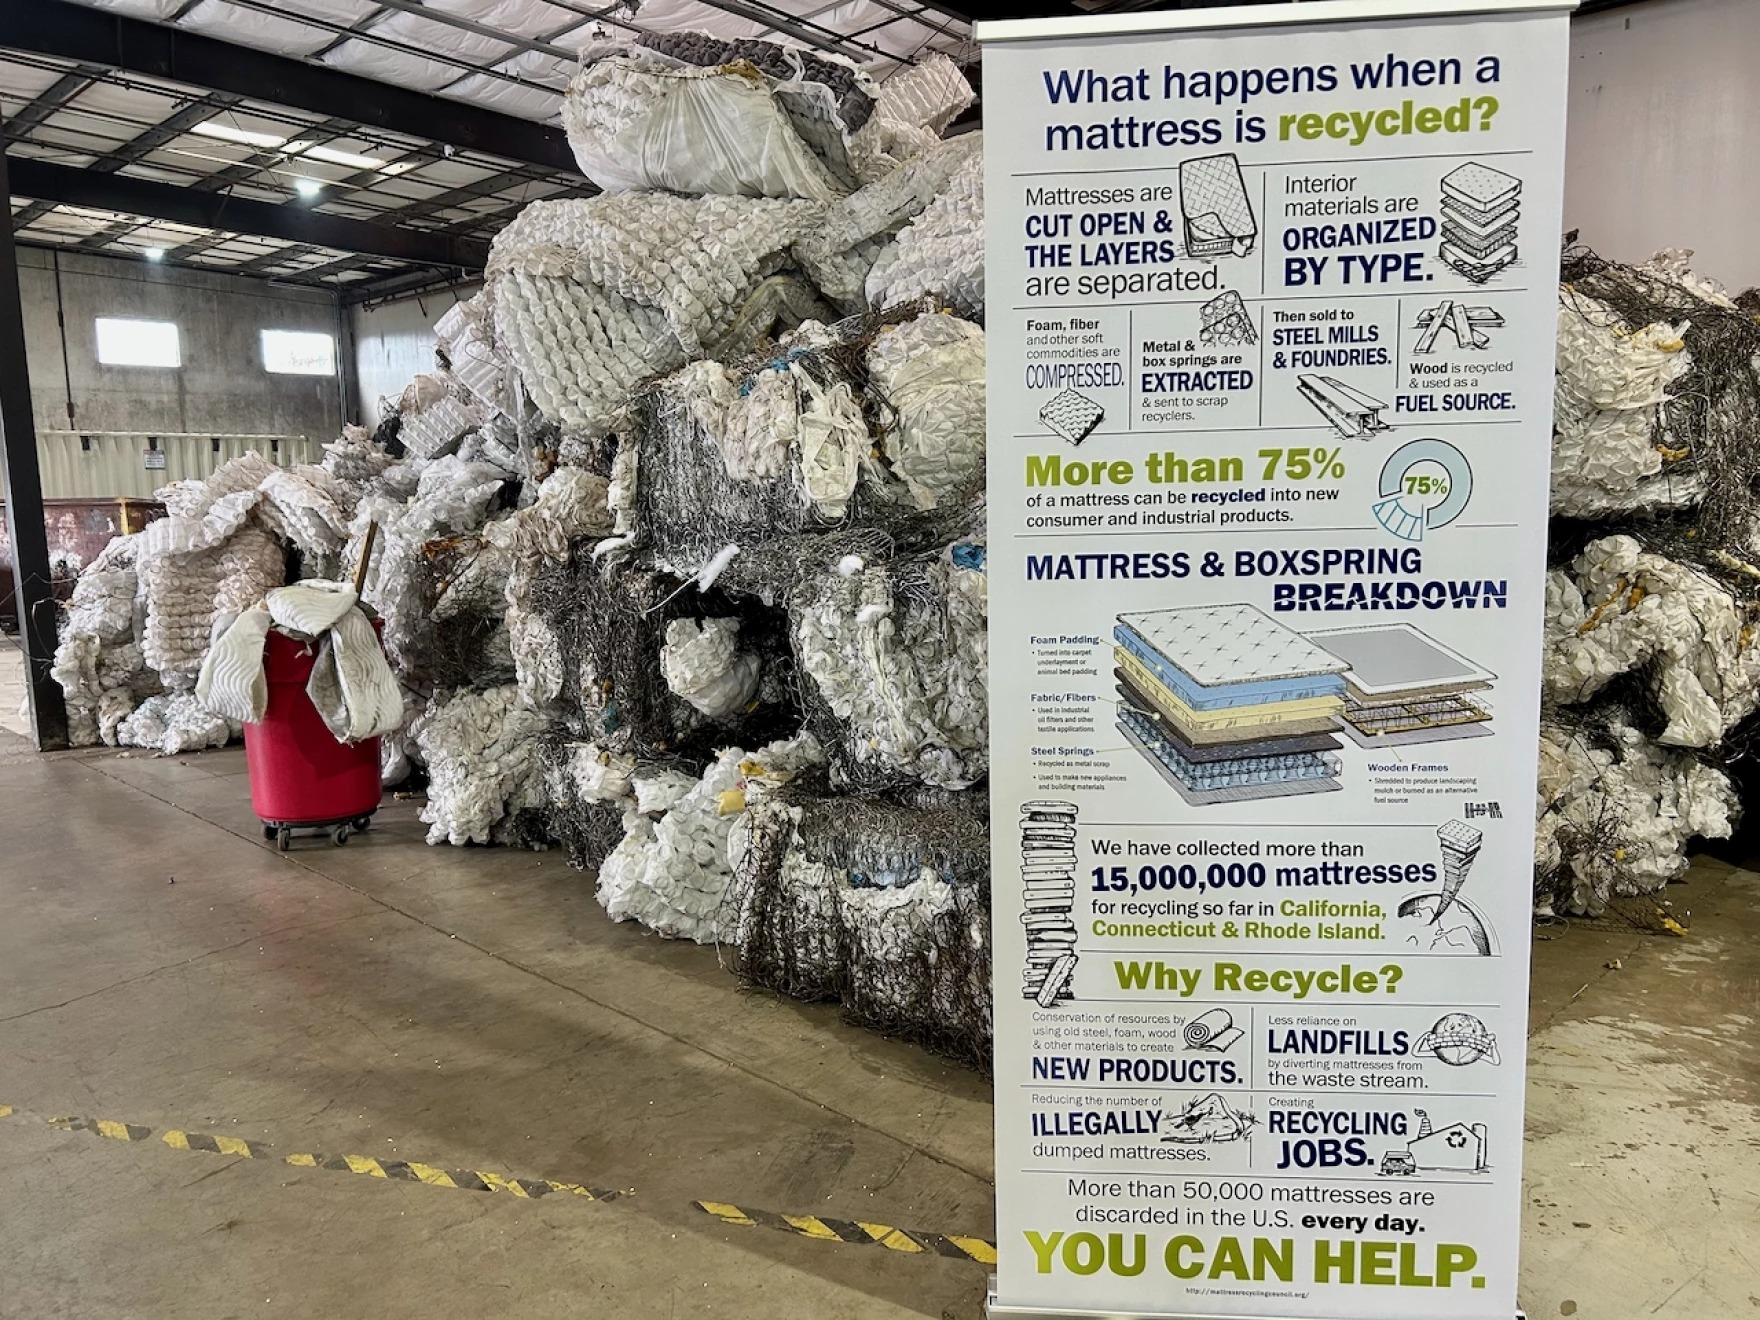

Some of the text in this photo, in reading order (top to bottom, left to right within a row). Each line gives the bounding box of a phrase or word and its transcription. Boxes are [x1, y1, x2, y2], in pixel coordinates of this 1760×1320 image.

[1043, 54, 1499, 105] What happens when a
[1047, 96, 1499, 150] mattress is recycled?
[1286, 174, 1357, 194] Interior
[1027, 187, 1172, 206] Mattresses are
[1286, 196, 1418, 216] materials are
[1026, 210, 1172, 238] CUT OPEN &
[1283, 217, 1436, 251] ORGANIZED
[1025, 240, 1175, 268] THE LAYERS
[1285, 253, 1433, 286] BY TYPE.
[1026, 265, 1226, 298] are separated.
[1027, 319, 1099, 331] Foam, fiber
[1273, 309, 1354, 322] Then sold to
[1027, 333, 1103, 345] and other soft
[1273, 325, 1378, 346] STEEL MILLS
[1027, 347, 1120, 359] commodities are
[1143, 340, 1195, 352] Metal &
[1143, 354, 1242, 368] box springs are
[1273, 348, 1391, 369] & FOUNDRIES.
[1410, 361, 1513, 374] Wood is recycled
[1026, 363, 1124, 389] COMPRESSED.
[1142, 370, 1253, 392] EXTRACTED
[1396, 392, 1515, 412] FUEL SOURCE.
[1142, 411, 1195, 423] recyclers.
[1027, 448, 1345, 486] More than 75%
[1405, 476, 1447, 494] 75%
[1027, 488, 1339, 508] of a mattress can be recycled into new
[1027, 509, 1293, 527] consumer and industrial products.
[1027, 548, 1421, 580] MATTRESS & BOXSPRING
[1274, 580, 1506, 611] BREAKDOWN
[1031, 635, 1099, 645] Foam Padding
[1031, 693, 1096, 703] Fabric/Fibers
[1031, 747, 1094, 756] Steel Springs
[1368, 764, 1448, 772] Wooden Frames
[1092, 840, 1363, 857] We have collected more than
[1092, 861, 1436, 897] 15,000,000 mattresses
[1092, 899, 1386, 920] for recycling so far in California,
[1092, 920, 1385, 939] Connecticut & Rhode Island.
[1114, 961, 1403, 998] Why Recycle?
[1032, 1012, 1186, 1026] Conservation of resources by
[1269, 1016, 1356, 1026] Less reliance on
[1033, 1027, 1176, 1038] using old steel, foam, wood
[1032, 1040, 1174, 1052] & other materials to create
[1269, 1030, 1408, 1056] LANDFILLS
[1033, 1057, 1242, 1084] NEW PRODUCTS.
[1268, 1058, 1422, 1071] by diverting mattresses from
[1268, 1071, 1428, 1088] the waste stream.
[1032, 1094, 1162, 1107] Reducing the number of
[1269, 1097, 1314, 1108] Creating
[1032, 1110, 1162, 1136] ILLEGALLY
[1269, 1111, 1407, 1136] RECYCLING
[1033, 1142, 1210, 1161] dumped mattresses.
[1277, 1138, 1374, 1169] JOBS.
[1069, 1179, 1434, 1206] More than 50,000 mattresses are
[1076, 1206, 1424, 1235] discarded in the U.S. every day.
[1024, 1232, 1485, 1288] YOU CAN HELP.
